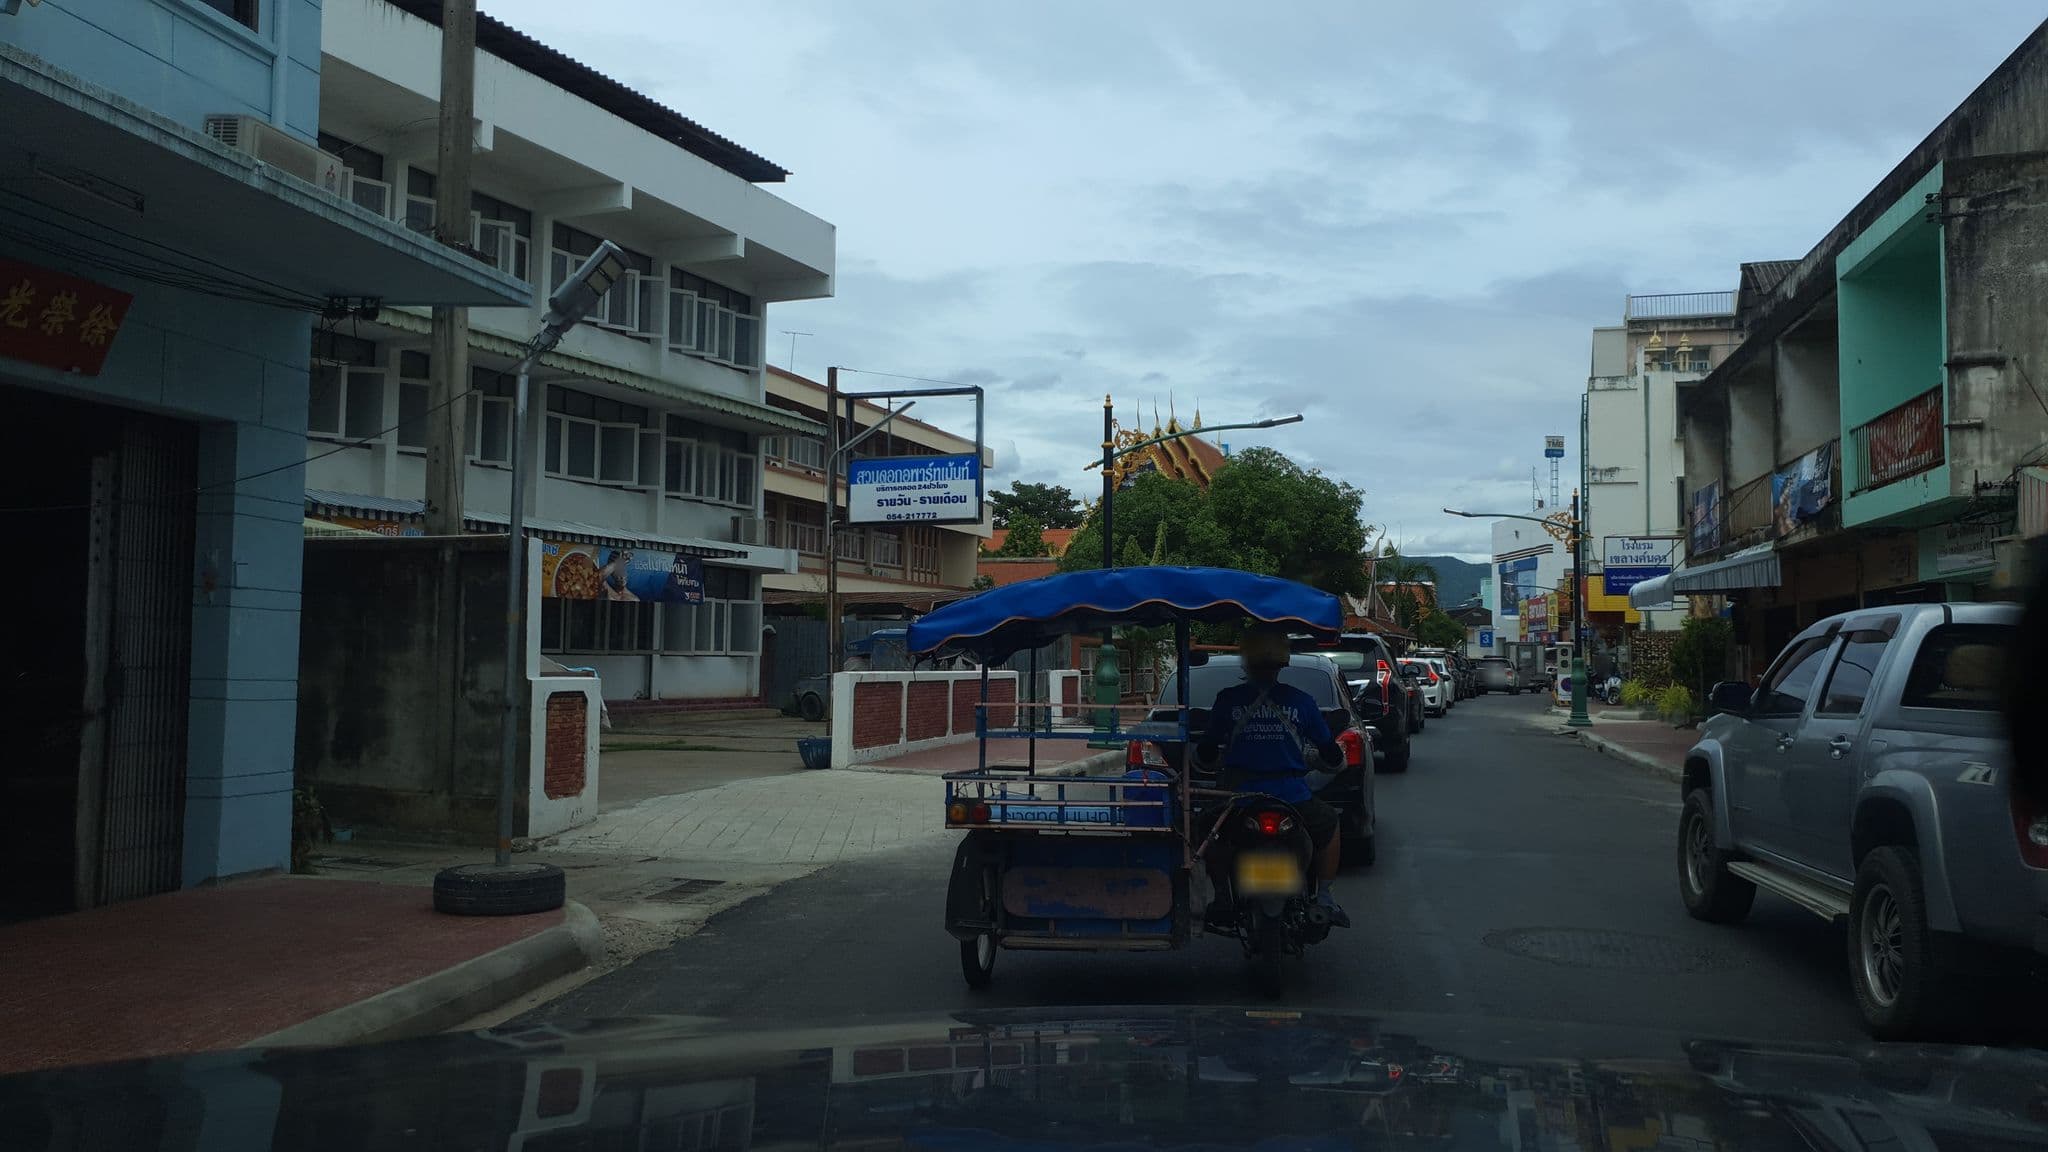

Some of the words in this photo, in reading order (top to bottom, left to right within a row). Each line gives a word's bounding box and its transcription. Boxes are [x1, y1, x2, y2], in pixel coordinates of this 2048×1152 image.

[877, 494, 911, 507] รายวัน
[919, 492, 967, 505] รายเดือน
[1620, 539, 1654, 550] โรงแรม
